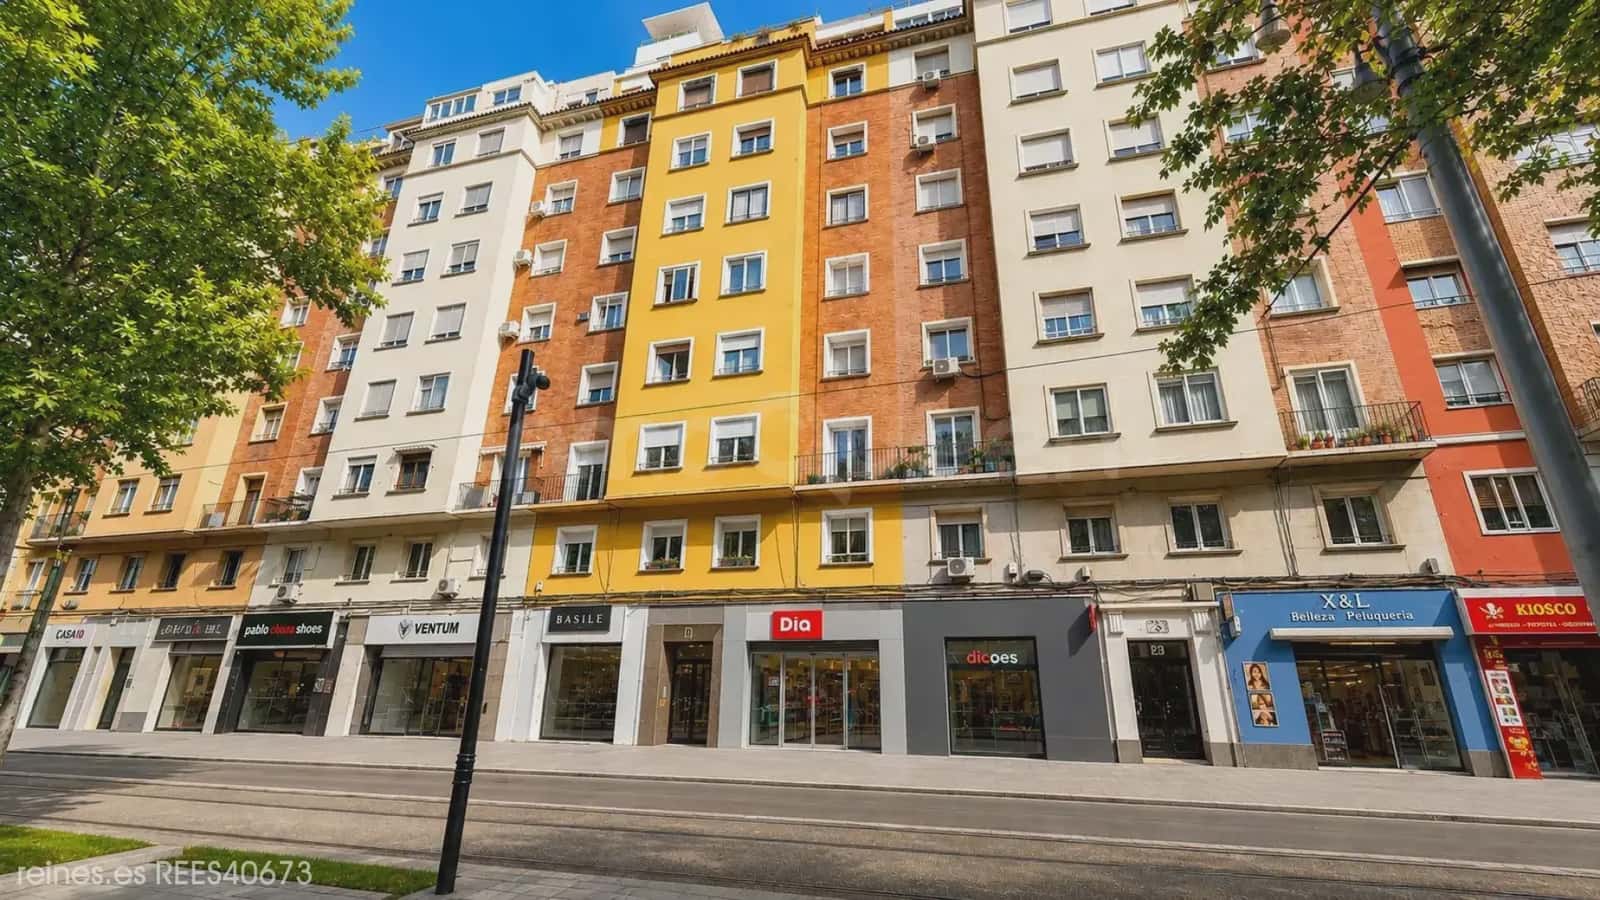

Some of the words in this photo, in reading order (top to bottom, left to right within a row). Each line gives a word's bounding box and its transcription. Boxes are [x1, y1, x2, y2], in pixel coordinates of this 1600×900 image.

[1321, 593, 1370, 609] X&L
[1515, 603, 1577, 616] KIOSCO
[556, 614, 604, 625] BASILE
[779, 616, 812, 632] Dia
[1290, 612, 1336, 622] Belleza
[244, 623, 269, 638] pablo
[295, 623, 323, 635] shoes
[414, 621, 460, 635] VENTUM
[966, 650, 1018, 664] dicoes
